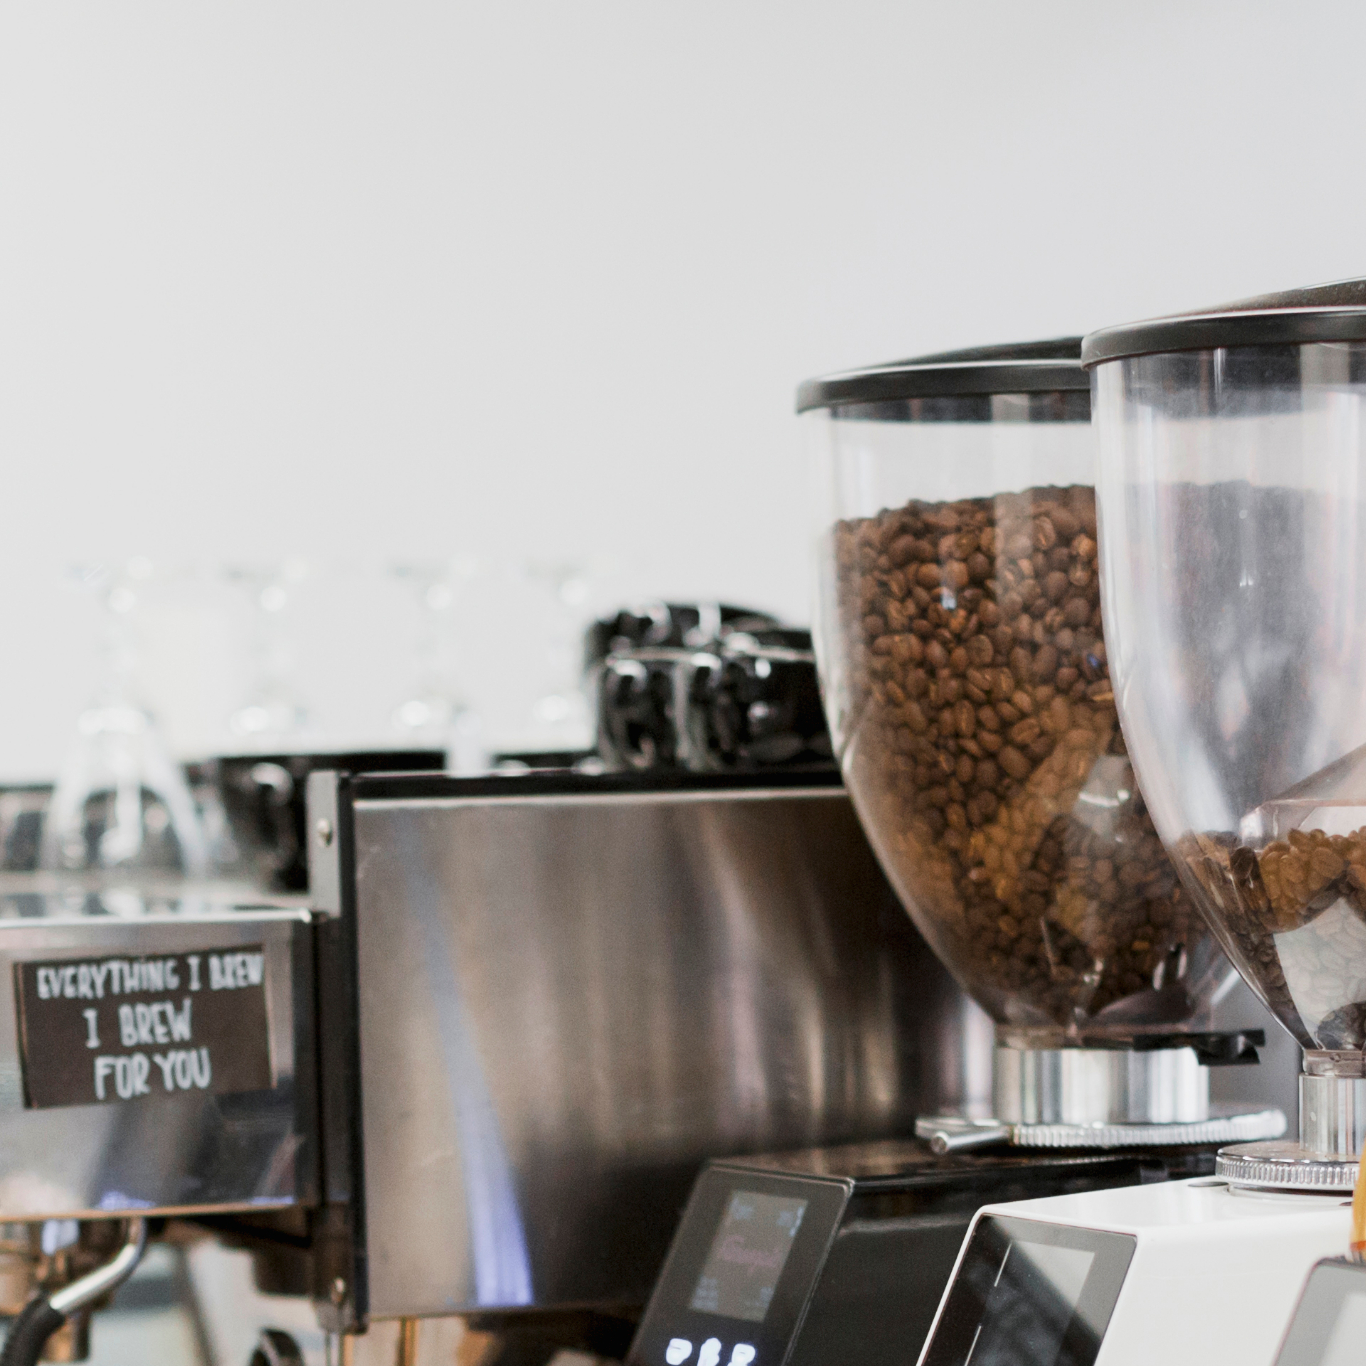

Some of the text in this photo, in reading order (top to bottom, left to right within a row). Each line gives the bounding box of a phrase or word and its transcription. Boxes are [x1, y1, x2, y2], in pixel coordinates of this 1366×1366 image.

[37, 953, 264, 999] EVERYTHING I BREW
[82, 997, 192, 1048] I BREW
[94, 1046, 212, 1100] FOR YOU
